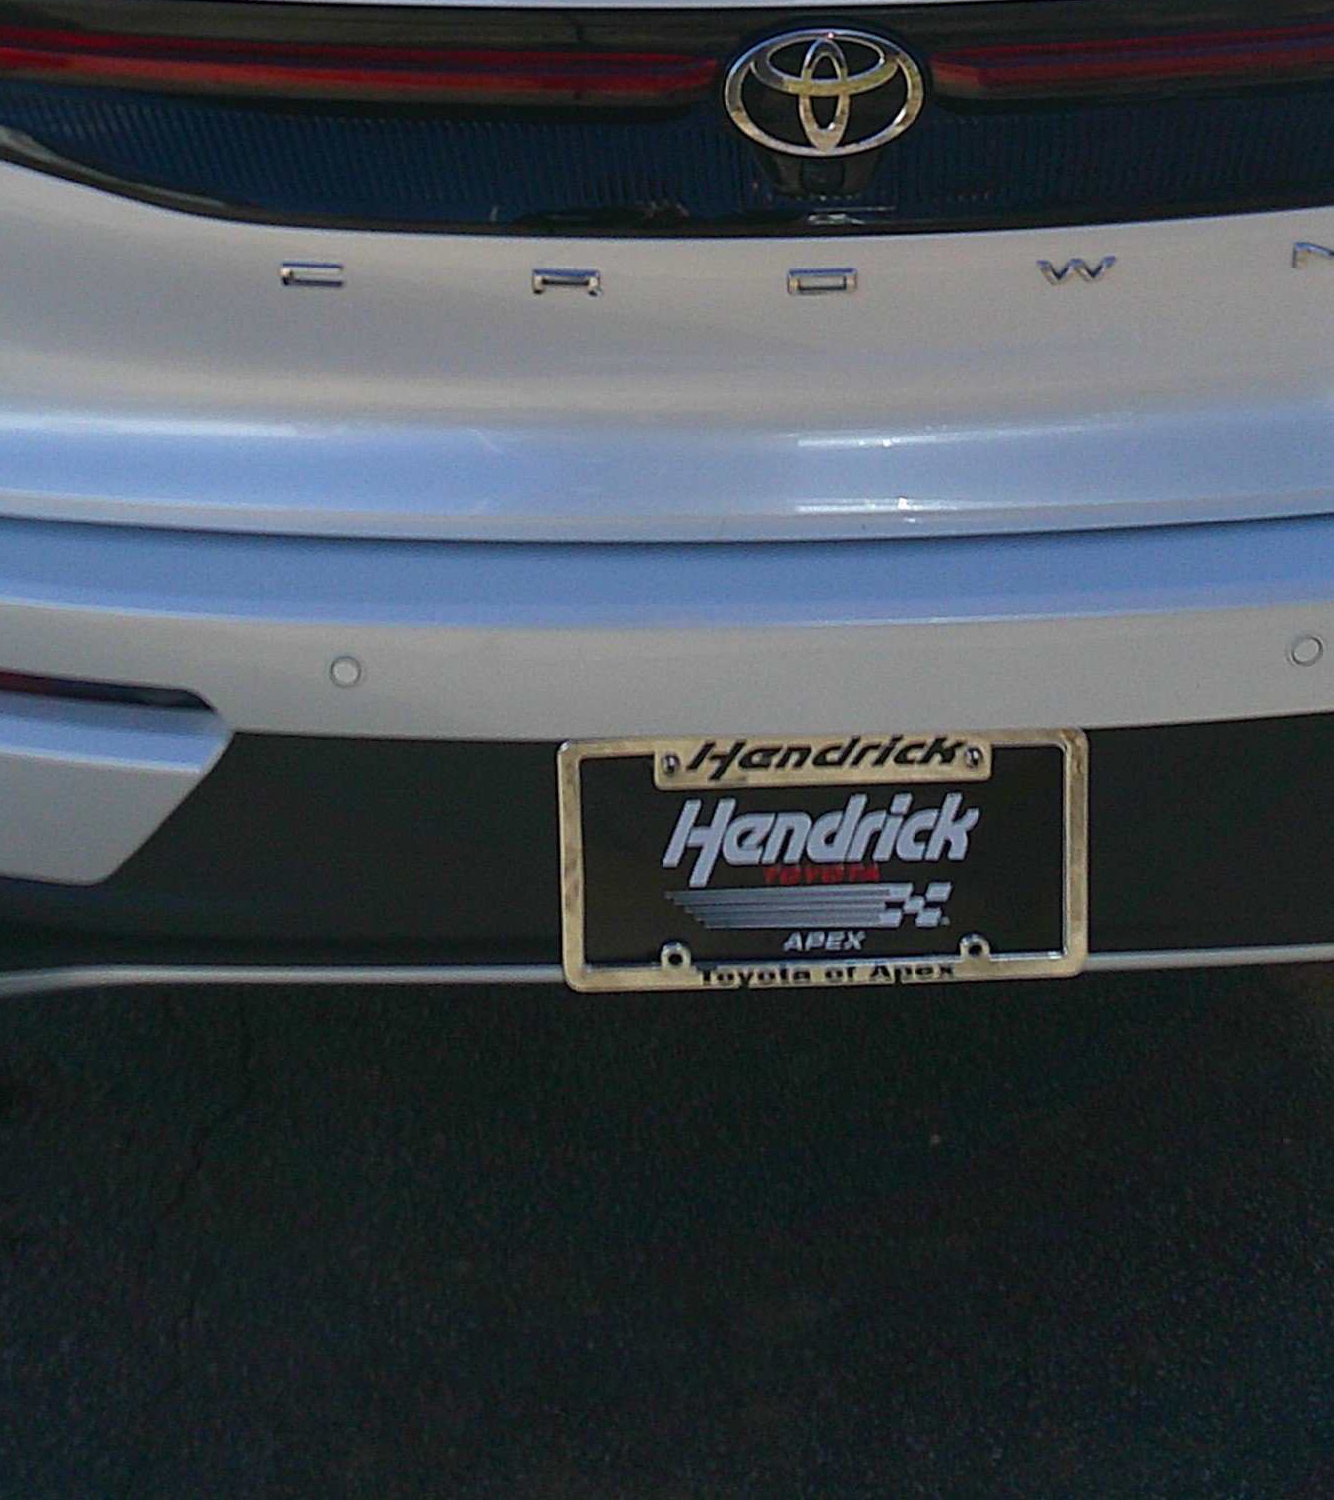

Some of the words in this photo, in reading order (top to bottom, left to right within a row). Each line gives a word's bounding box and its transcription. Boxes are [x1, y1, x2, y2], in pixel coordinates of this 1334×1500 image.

[685, 733, 966, 781] Hendrick
[661, 792, 981, 889] Hendrick
[762, 862, 882, 886] TOYOTA
[783, 930, 867, 952] APEX
[700, 964, 812, 992] Toyota
[823, 966, 856, 980] of
[870, 961, 956, 985] Apex
